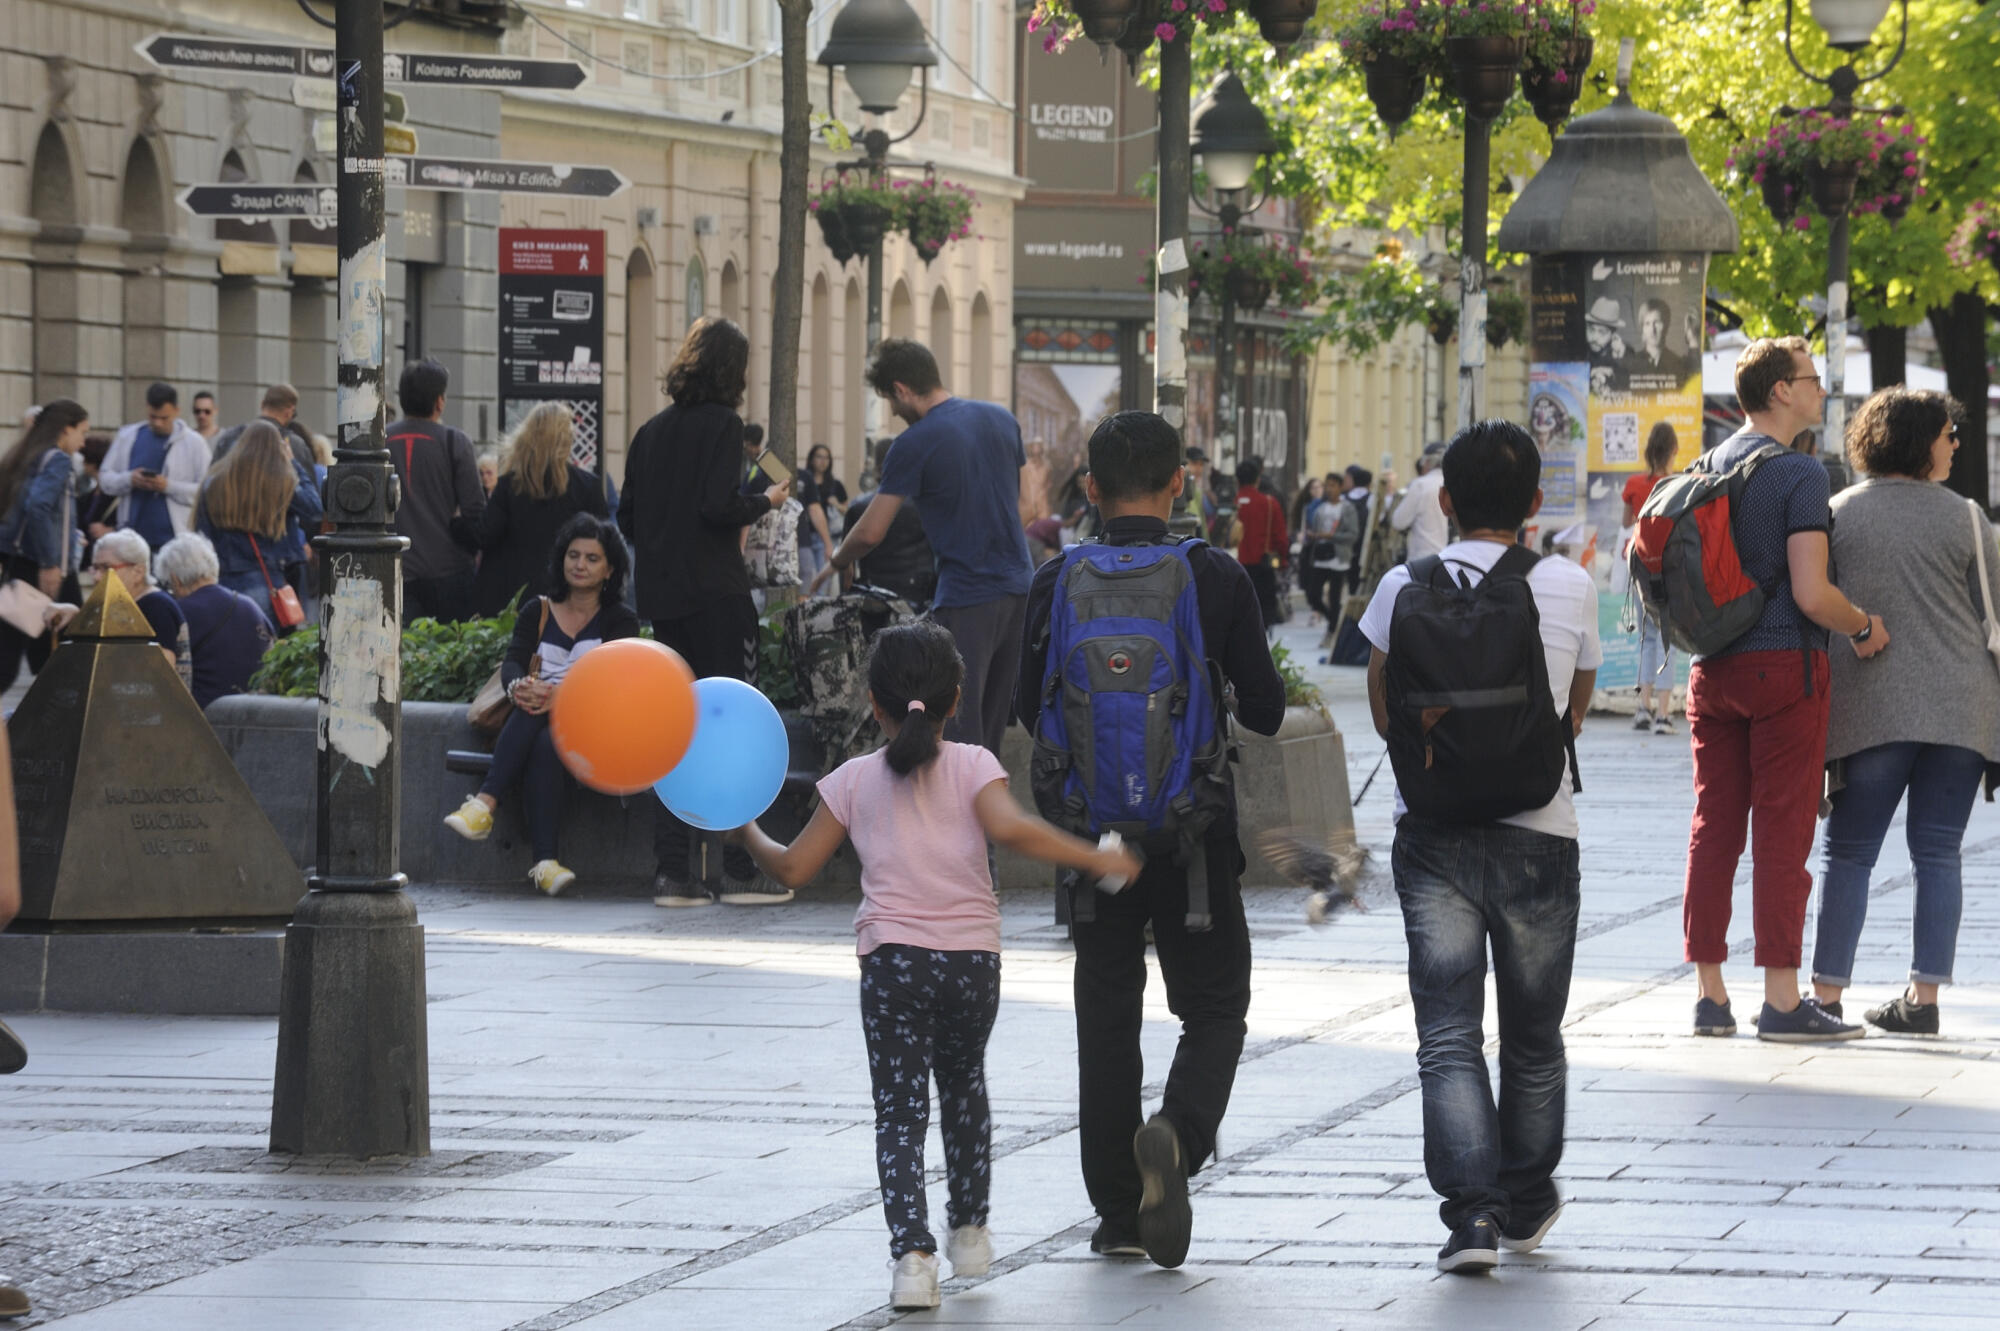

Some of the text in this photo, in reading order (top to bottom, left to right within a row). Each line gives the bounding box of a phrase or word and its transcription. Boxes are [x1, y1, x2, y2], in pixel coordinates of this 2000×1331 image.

[415, 62, 522, 80] Kolarac Foundation
[1031, 104, 1113, 127] LEGEND
[474, 168, 515, 185] Misa's
[518, 171, 562, 188] Edifice
[231, 194, 272, 210] Зграда
[1024, 240, 1123, 260] www.legend.rs
[1616, 260, 1682, 276] Lovefest.19
[131, 812, 209, 831] ВИСИНА
